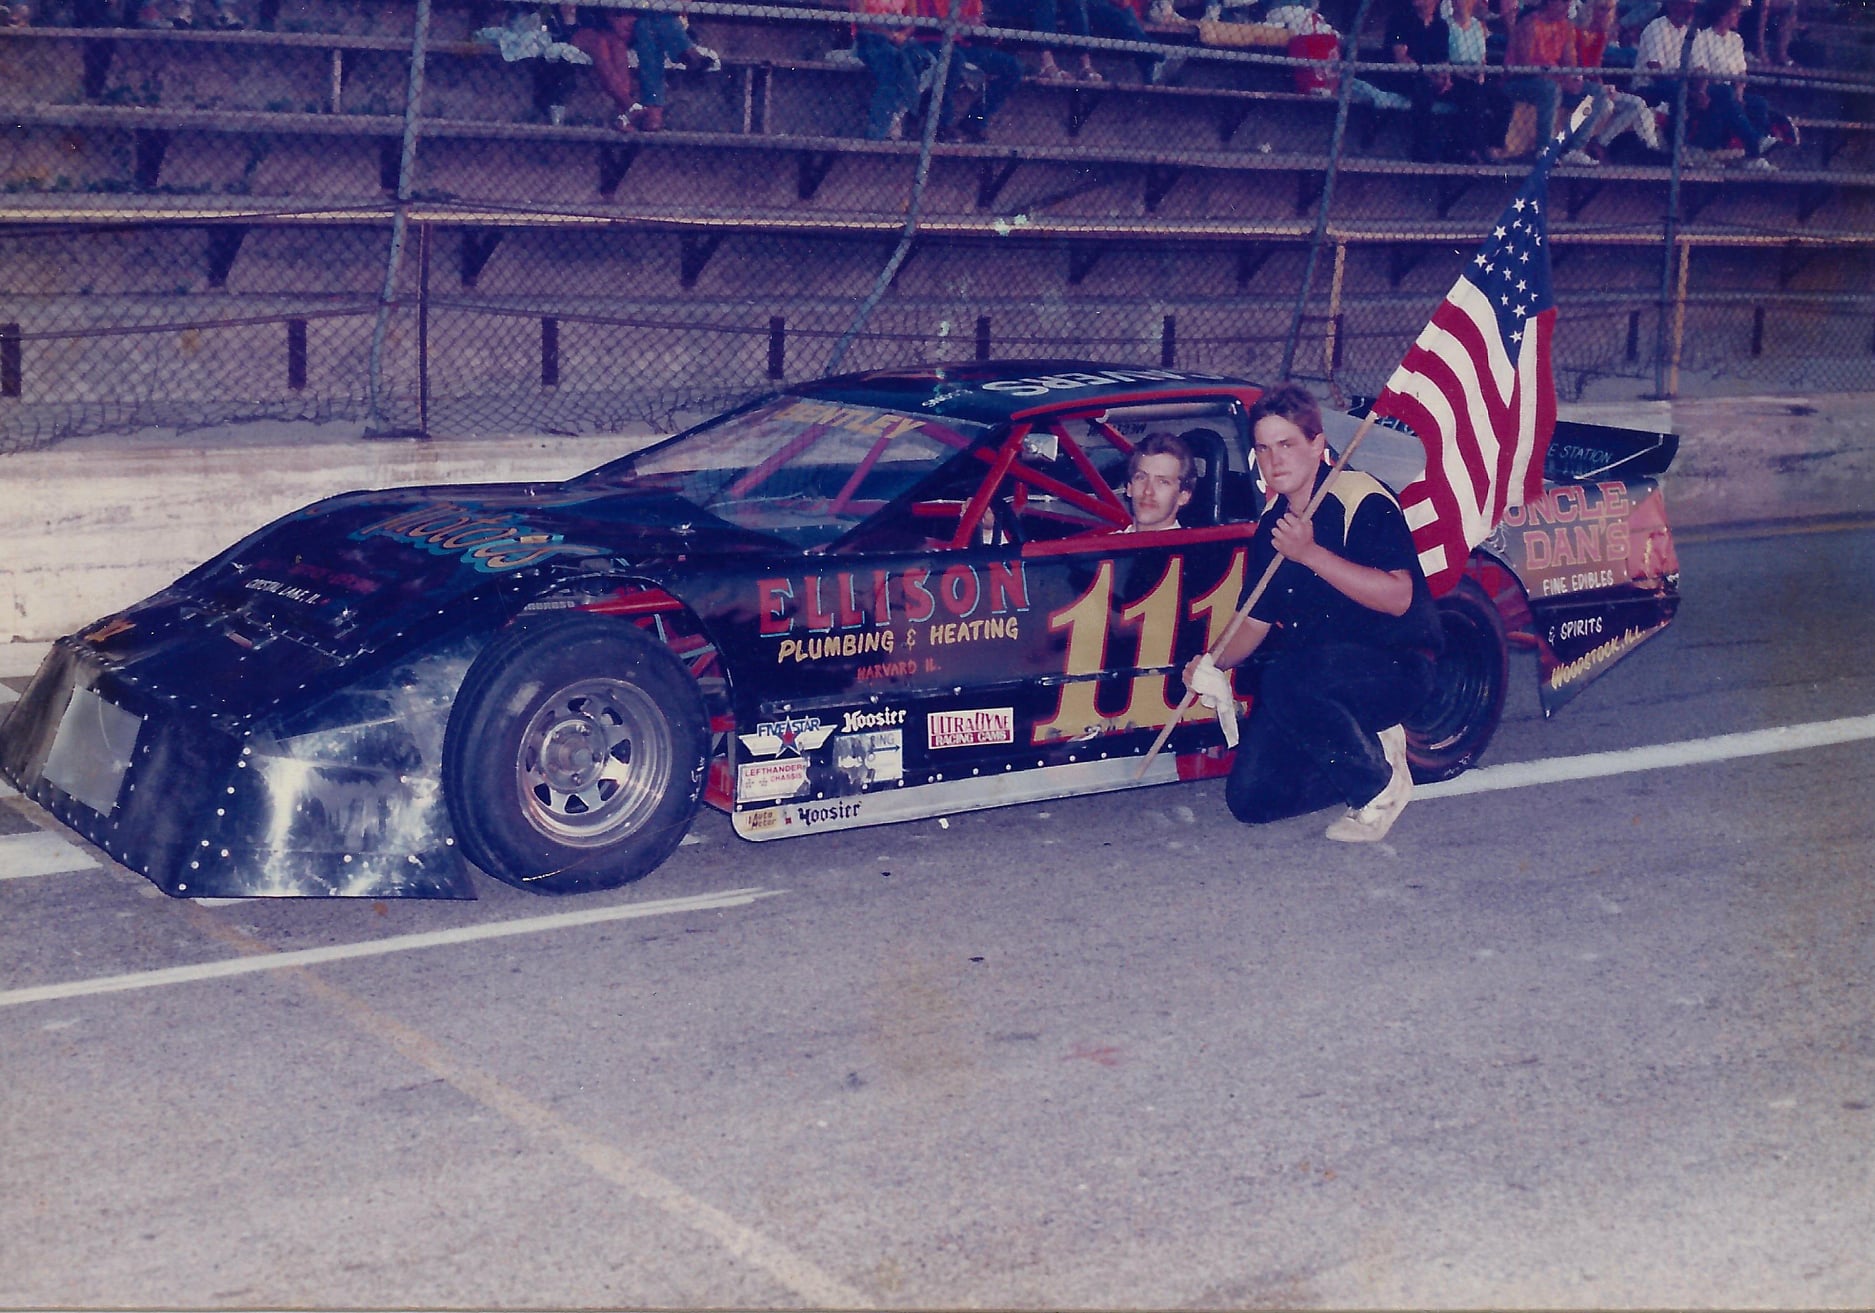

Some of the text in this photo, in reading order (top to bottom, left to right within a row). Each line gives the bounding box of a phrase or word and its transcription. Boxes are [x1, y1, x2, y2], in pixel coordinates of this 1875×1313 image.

[774, 402, 927, 439] BENTLEY
[1560, 444, 1613, 463] STATION
[1503, 481, 1629, 527] UNCLE
[1523, 520, 1631, 570] DAN'S
[1543, 569, 1614, 596] FINE EDIBLES
[756, 559, 1030, 637] ELLISON
[778, 630, 894, 663] PLUMBING
[929, 616, 1019, 646] HEATING
[1560, 616, 1603, 640] SPIRITS
[1030, 547, 1254, 746] 111
[856, 659, 917, 680] HARVARD
[840, 706, 907, 733] Hoosier
[937, 730, 1006, 746] RACING CAMS
[744, 763, 804, 778] LEFTHANDER
[770, 773, 803, 783] CHASSIS
[797, 801, 863, 826] Hoosier
